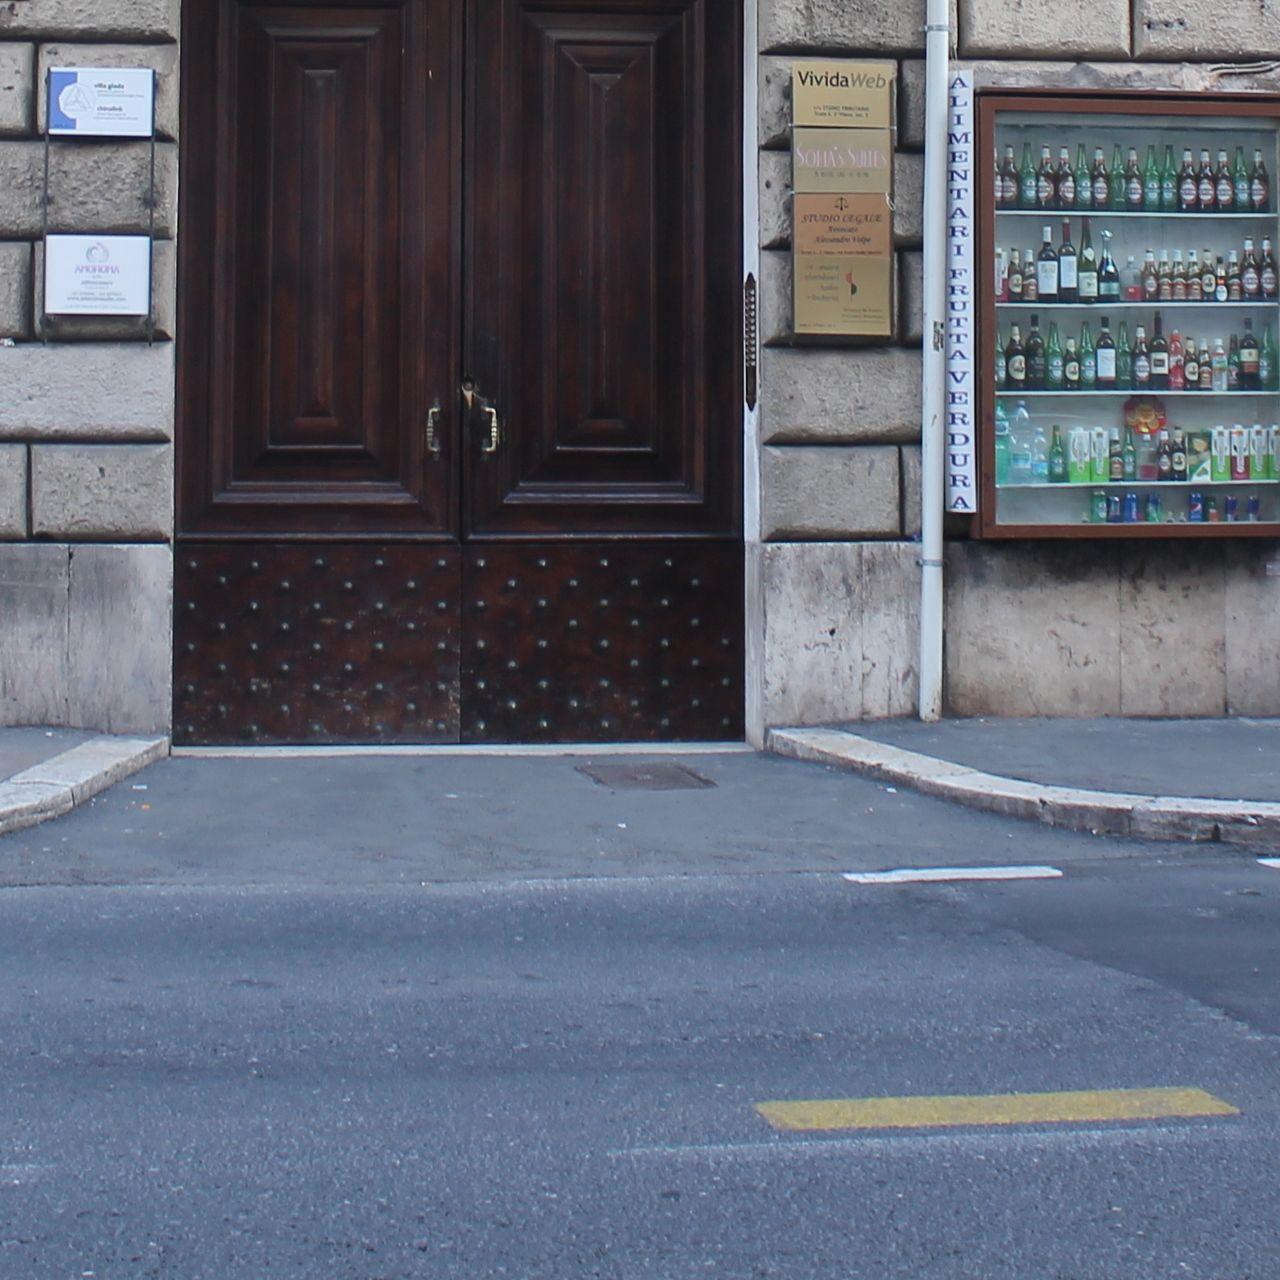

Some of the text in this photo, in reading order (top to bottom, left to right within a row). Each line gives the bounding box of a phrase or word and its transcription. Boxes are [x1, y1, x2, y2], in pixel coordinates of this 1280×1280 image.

[948, 77, 971, 510] ALIMENTARI FRUTTA VERDURA
